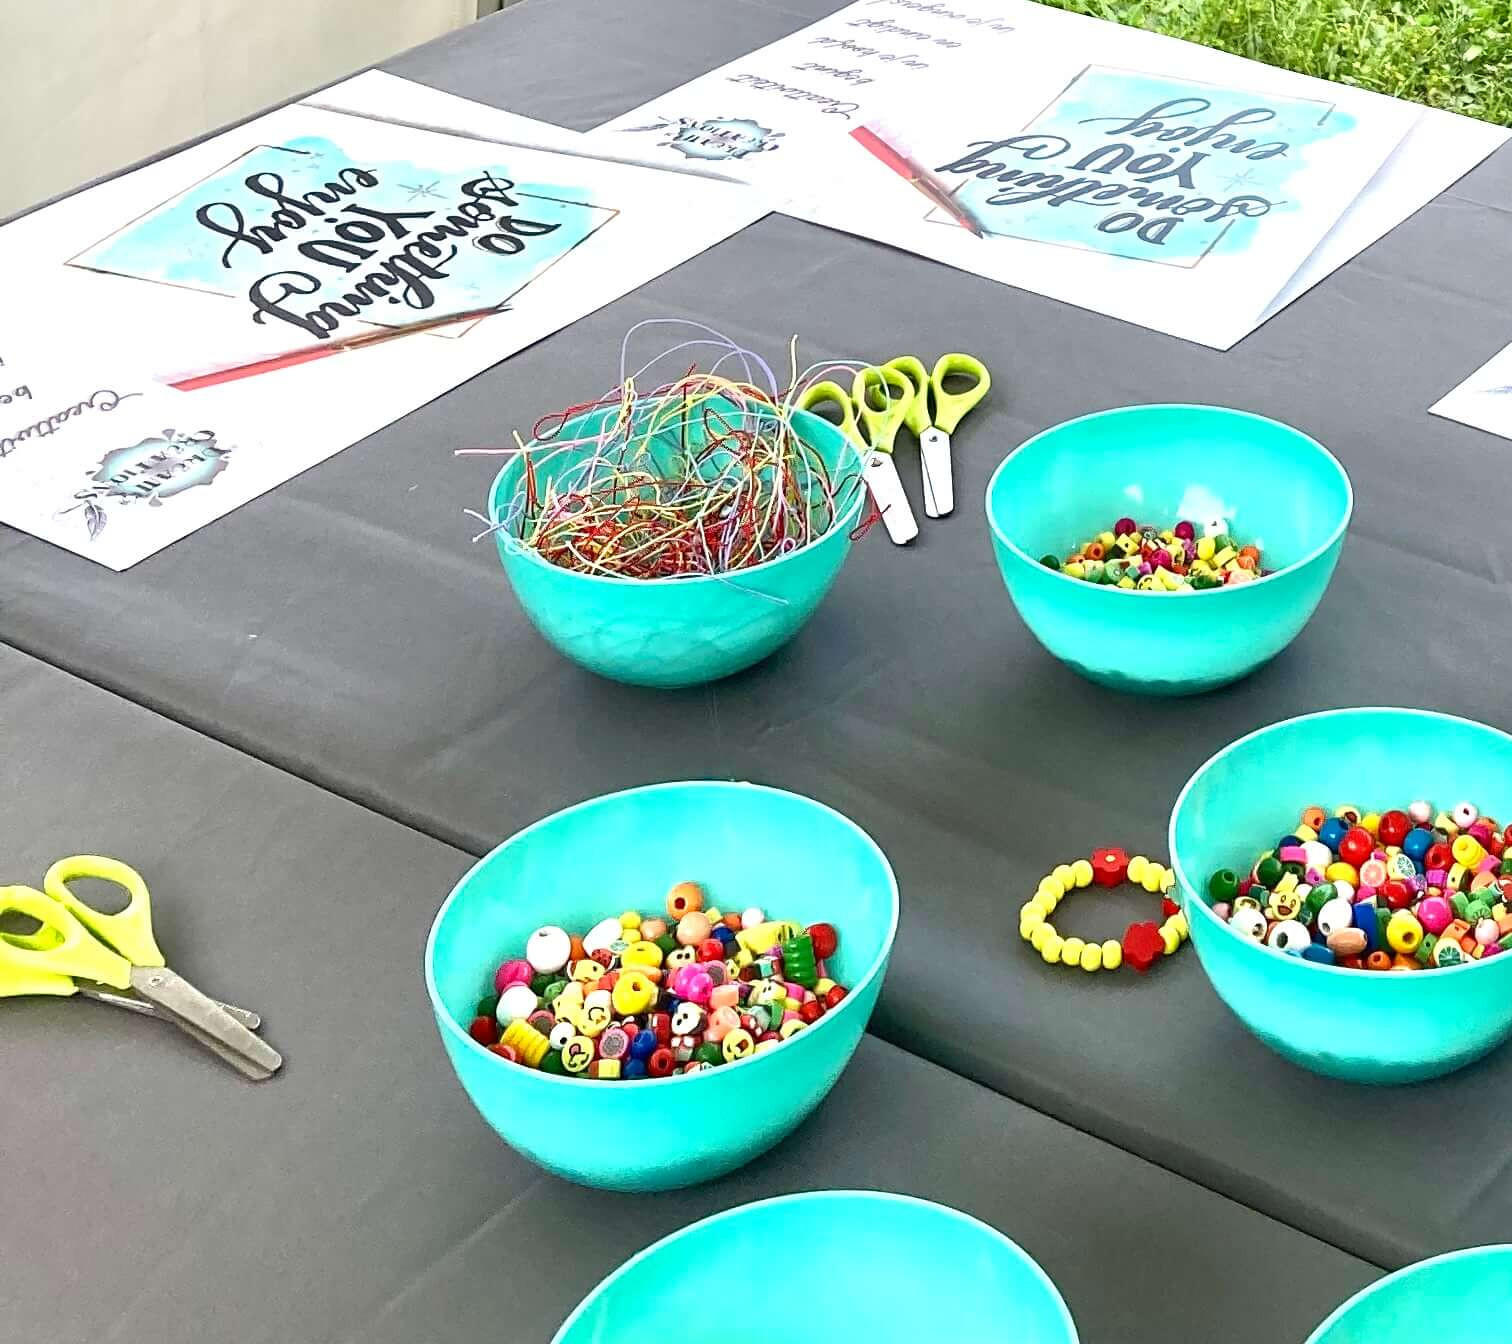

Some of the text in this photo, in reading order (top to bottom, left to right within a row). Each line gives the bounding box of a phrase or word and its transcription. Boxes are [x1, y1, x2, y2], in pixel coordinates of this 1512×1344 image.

[1077, 97, 1290, 160] enjoy
[196, 167, 380, 270] enjoy
[0, 389, 144, 458] Creativit
